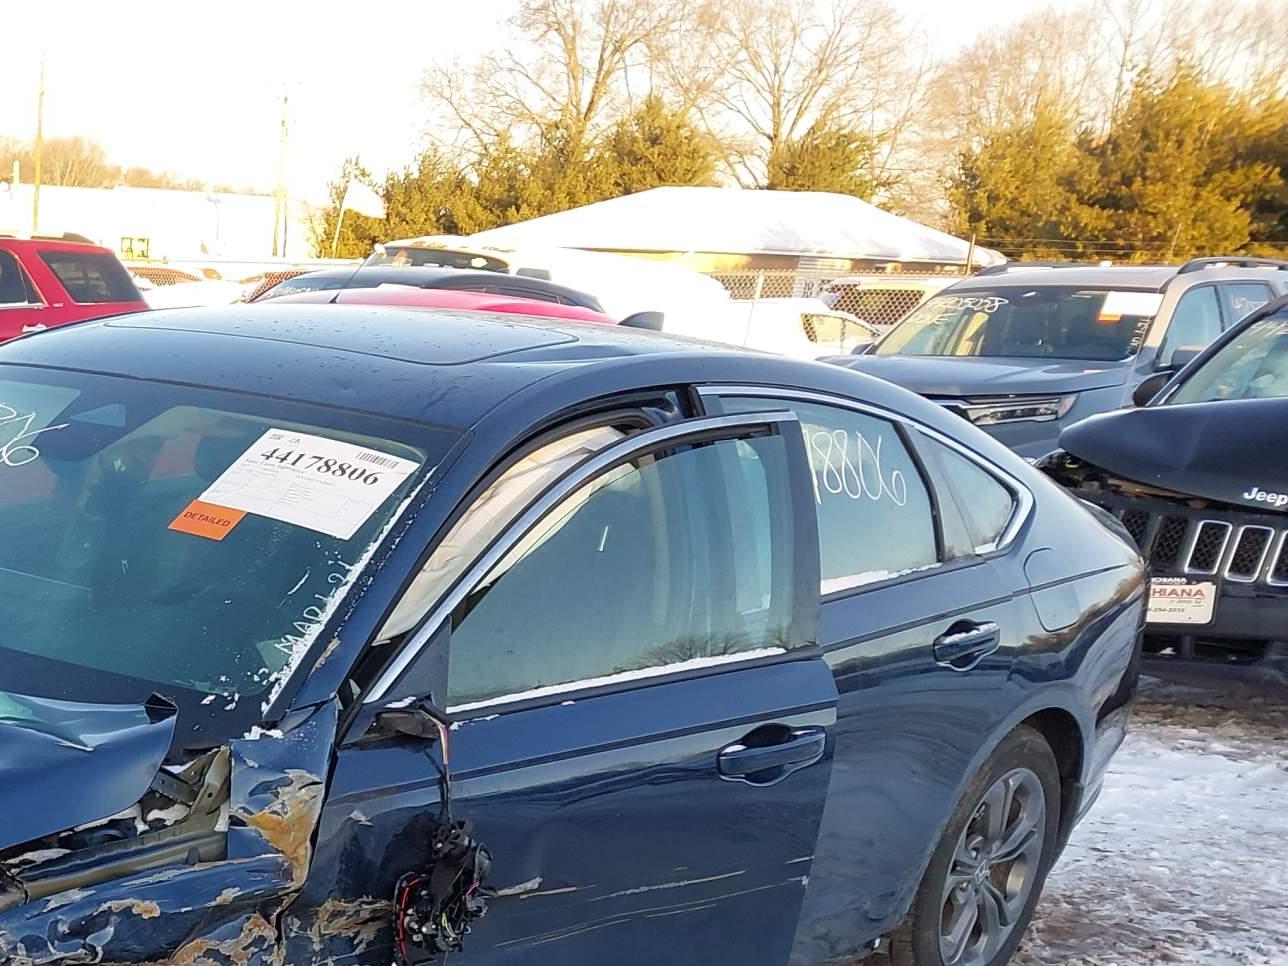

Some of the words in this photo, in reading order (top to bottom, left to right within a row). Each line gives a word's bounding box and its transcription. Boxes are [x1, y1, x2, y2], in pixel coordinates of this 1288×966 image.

[260, 446, 383, 486] 44178806
[1243, 487, 1288, 507] Jeep
[183, 510, 231, 528] DETAILED
